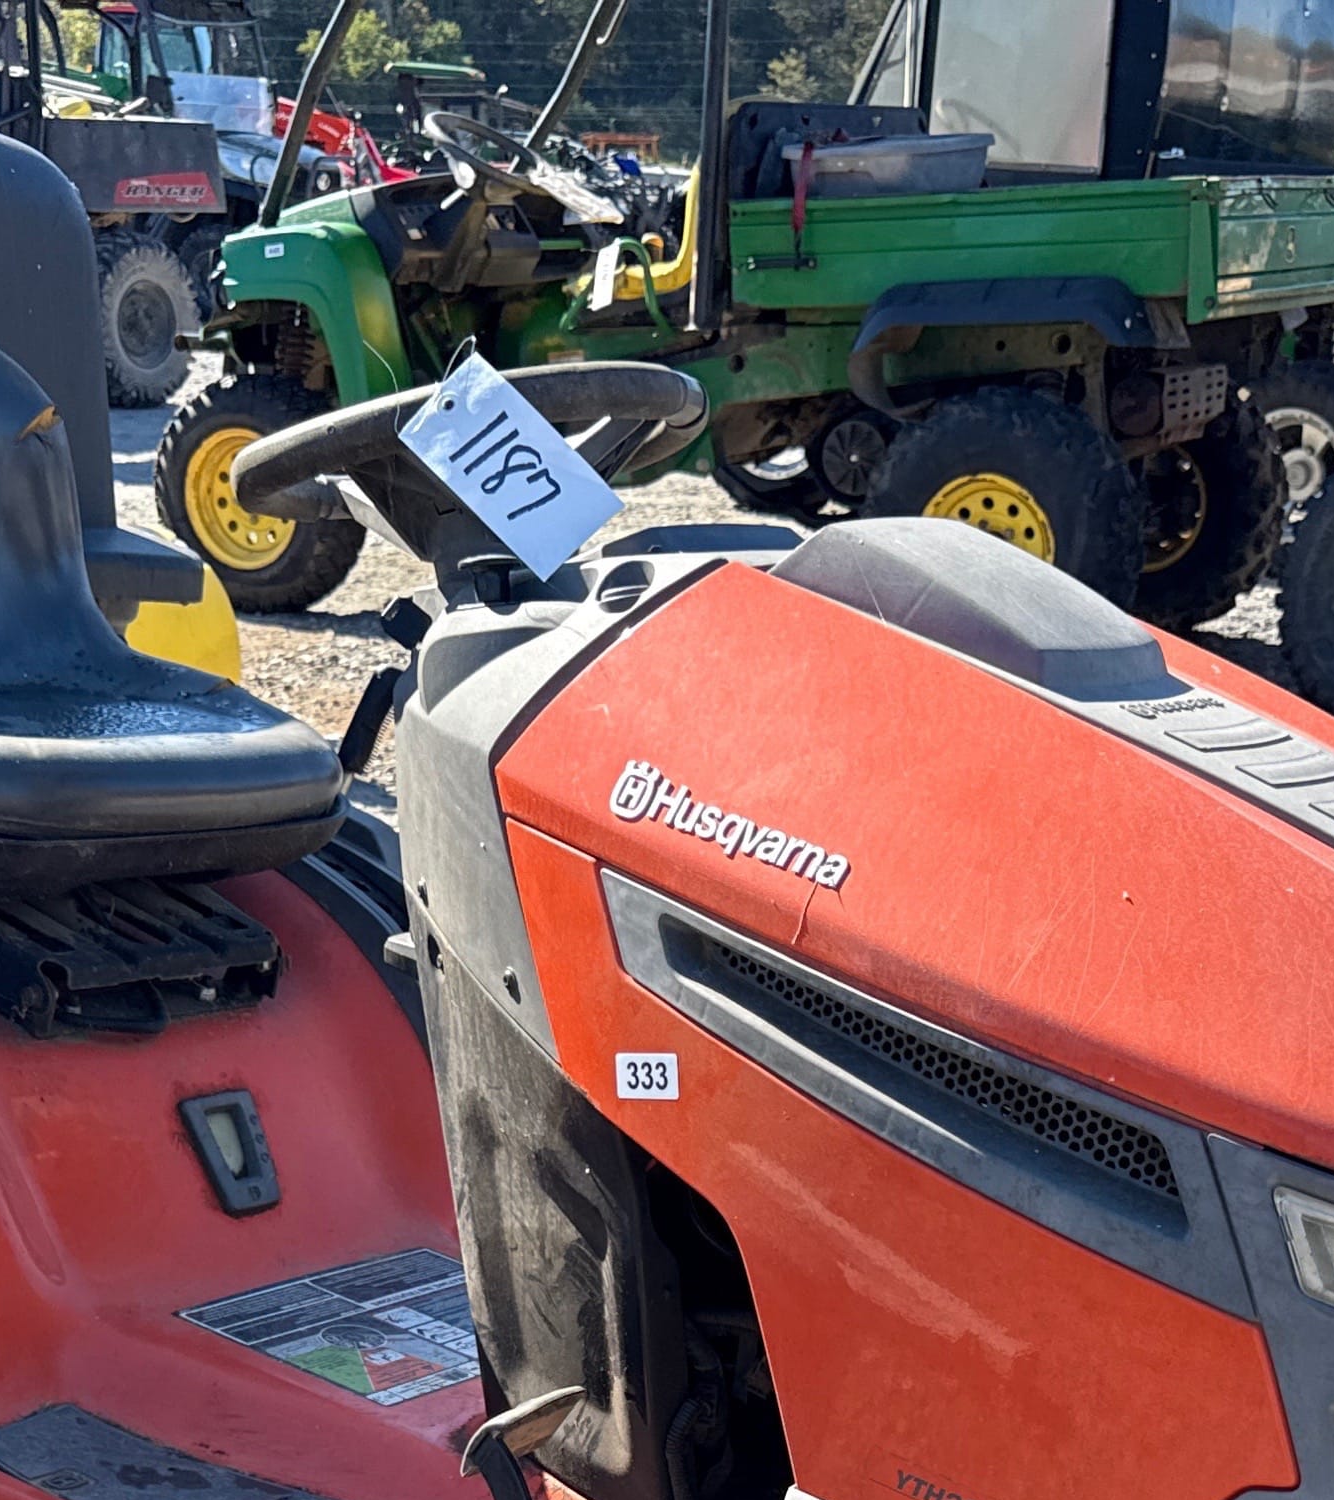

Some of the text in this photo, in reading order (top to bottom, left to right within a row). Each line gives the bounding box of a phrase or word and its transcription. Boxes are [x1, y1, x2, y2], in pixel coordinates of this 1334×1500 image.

[123, 184, 206, 199] RANGER
[449, 410, 561, 521] 1187
[647, 777, 850, 890] Husqvarna
[627, 1061, 668, 1090] 333
